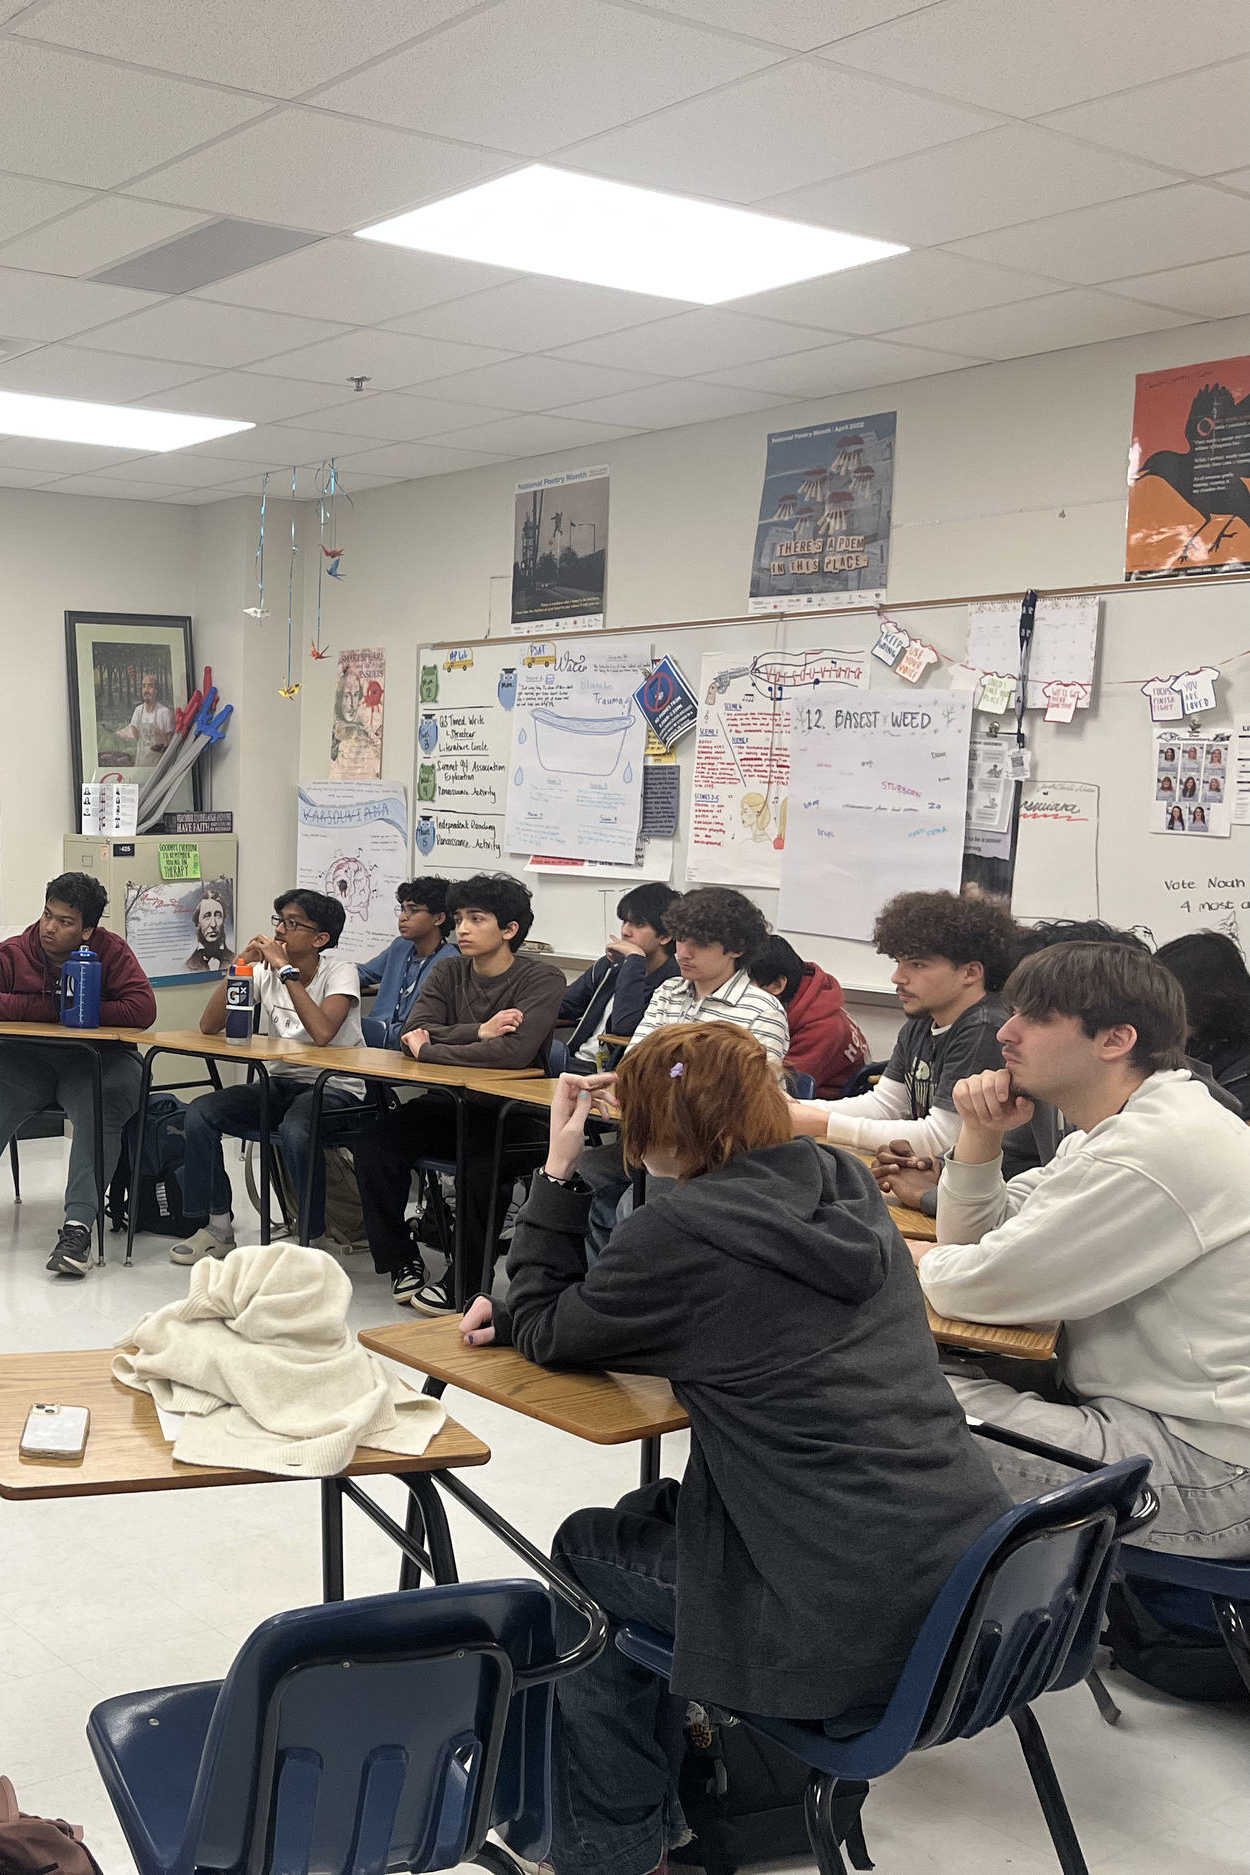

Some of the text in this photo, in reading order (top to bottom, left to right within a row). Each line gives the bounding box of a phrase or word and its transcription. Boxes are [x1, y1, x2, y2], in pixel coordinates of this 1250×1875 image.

[772, 435, 794, 443] National
[813, 428, 831, 436] Month
[518, 472, 587, 490] National Poetry Month
[779, 537, 864, 555] THERE'S A POEM
[772, 563, 785, 574] IN
[791, 560, 818, 572] THIS
[884, 631, 902, 648] KEEP
[450, 651, 457, 660] AP
[530, 645, 546, 656] PSAT
[878, 641, 896, 658] GOING
[909, 647, 923, 660] USE
[340, 652, 384, 663] SHAKESPEARE
[554, 651, 587, 672] Water
[905, 655, 922, 669] YOUR
[360, 670, 383, 678] INSULTS
[899, 664, 917, 679] VOICE
[580, 678, 614, 690] Blanche
[1183, 681, 1197, 690] YOU
[426, 688, 432, 698] 2
[593, 692, 623, 705] Trauma
[1185, 692, 1198, 701] ARE
[670, 696, 681, 706] FROM
[1186, 698, 1209, 711] LOVED
[440, 714, 485, 727] Q3 Timed Write
[806, 709, 825, 730] 12.
[835, 709, 880, 729] BASEST
[891, 712, 931, 729] WEED
[424, 740, 429, 749] 3
[439, 742, 488, 752] Literature Circle
[437, 760, 458, 771] Sonnet
[472, 761, 505, 771] Association
[444, 773, 474, 783] Explication
[438, 786, 496, 804] Renaissance Activity
[881, 781, 921, 798] STUBBORN
[176, 823, 192, 832] HAVE
[193, 822, 210, 832] FAITH
[471, 820, 496, 839] Reading
[423, 837, 428, 847] 5
[436, 835, 501, 858] Renaissance Activity
[164, 865, 188, 878] THERAPY
[1164, 877, 1245, 891] Vote Noah
[1180, 900, 1234, 913] 4 most
[156, 1182, 170, 1216] PUMA
